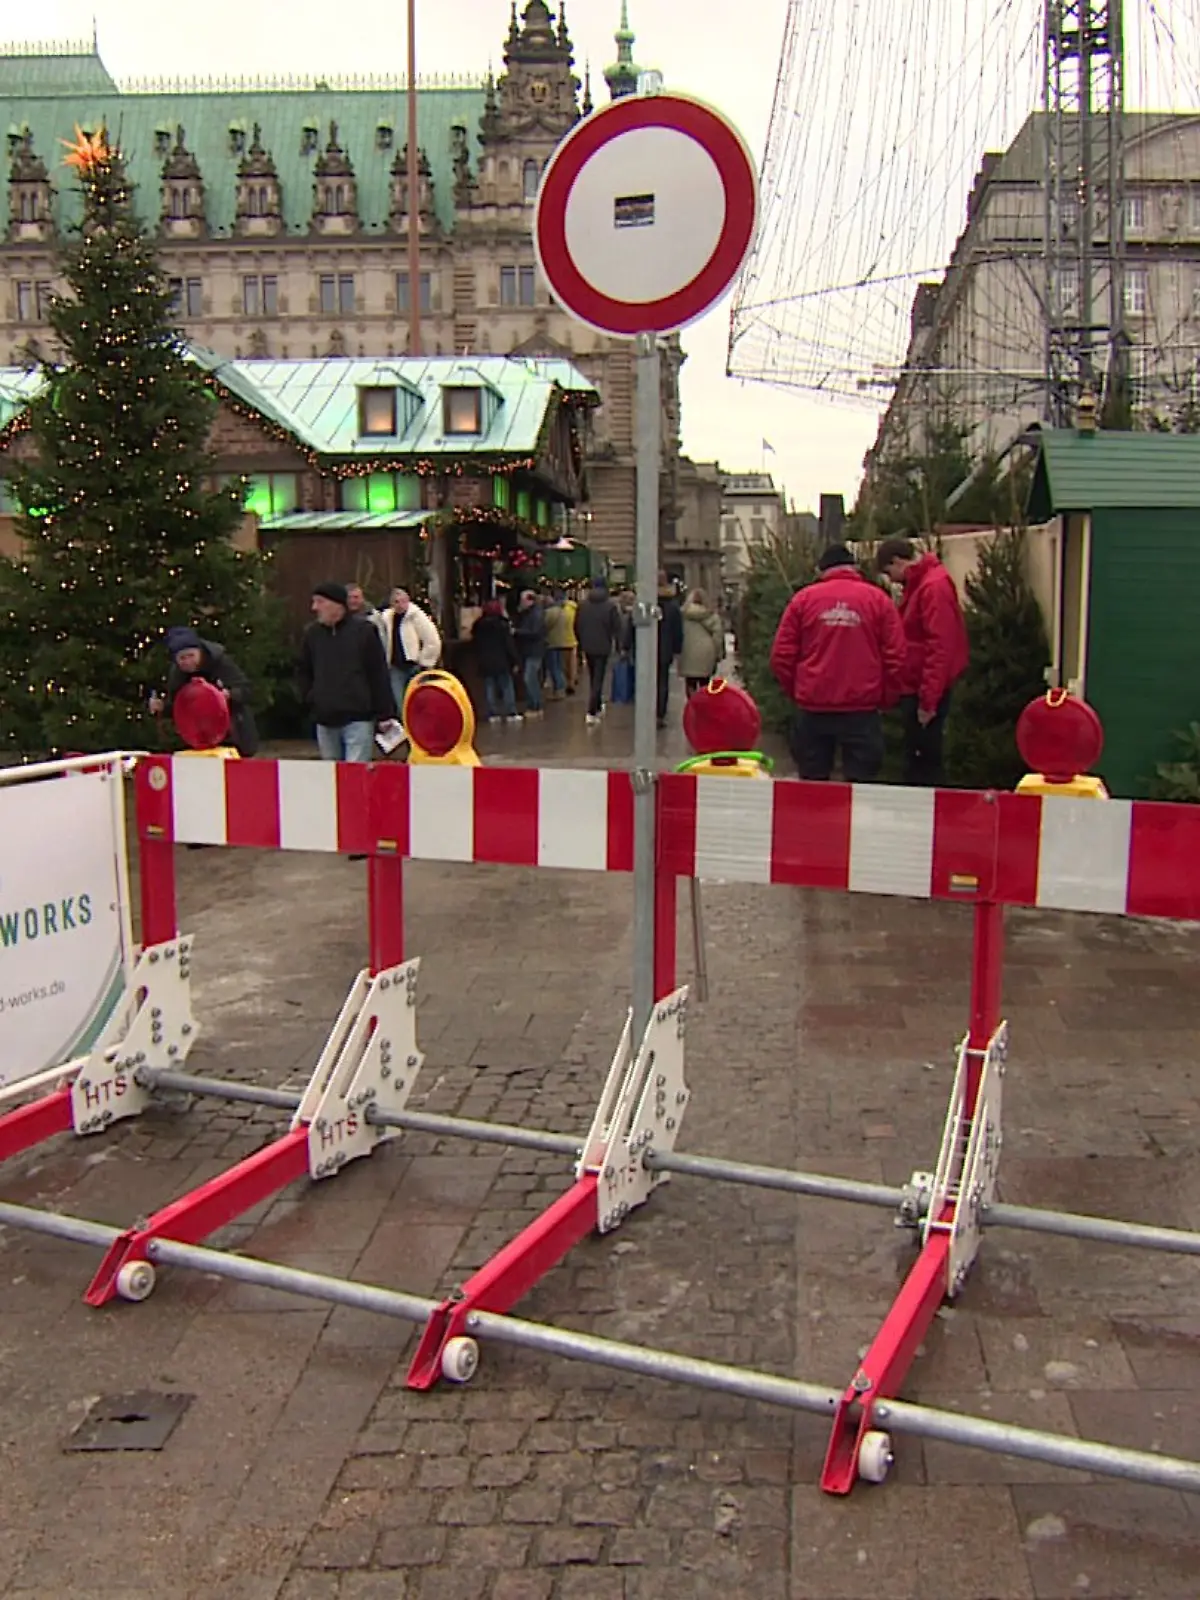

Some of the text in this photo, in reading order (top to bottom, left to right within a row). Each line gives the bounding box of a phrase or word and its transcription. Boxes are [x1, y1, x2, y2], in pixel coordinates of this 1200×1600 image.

[0, 893, 92, 947] WORKS
[84, 1075, 127, 1109] HTS
[320, 1112, 358, 1151] HTS
